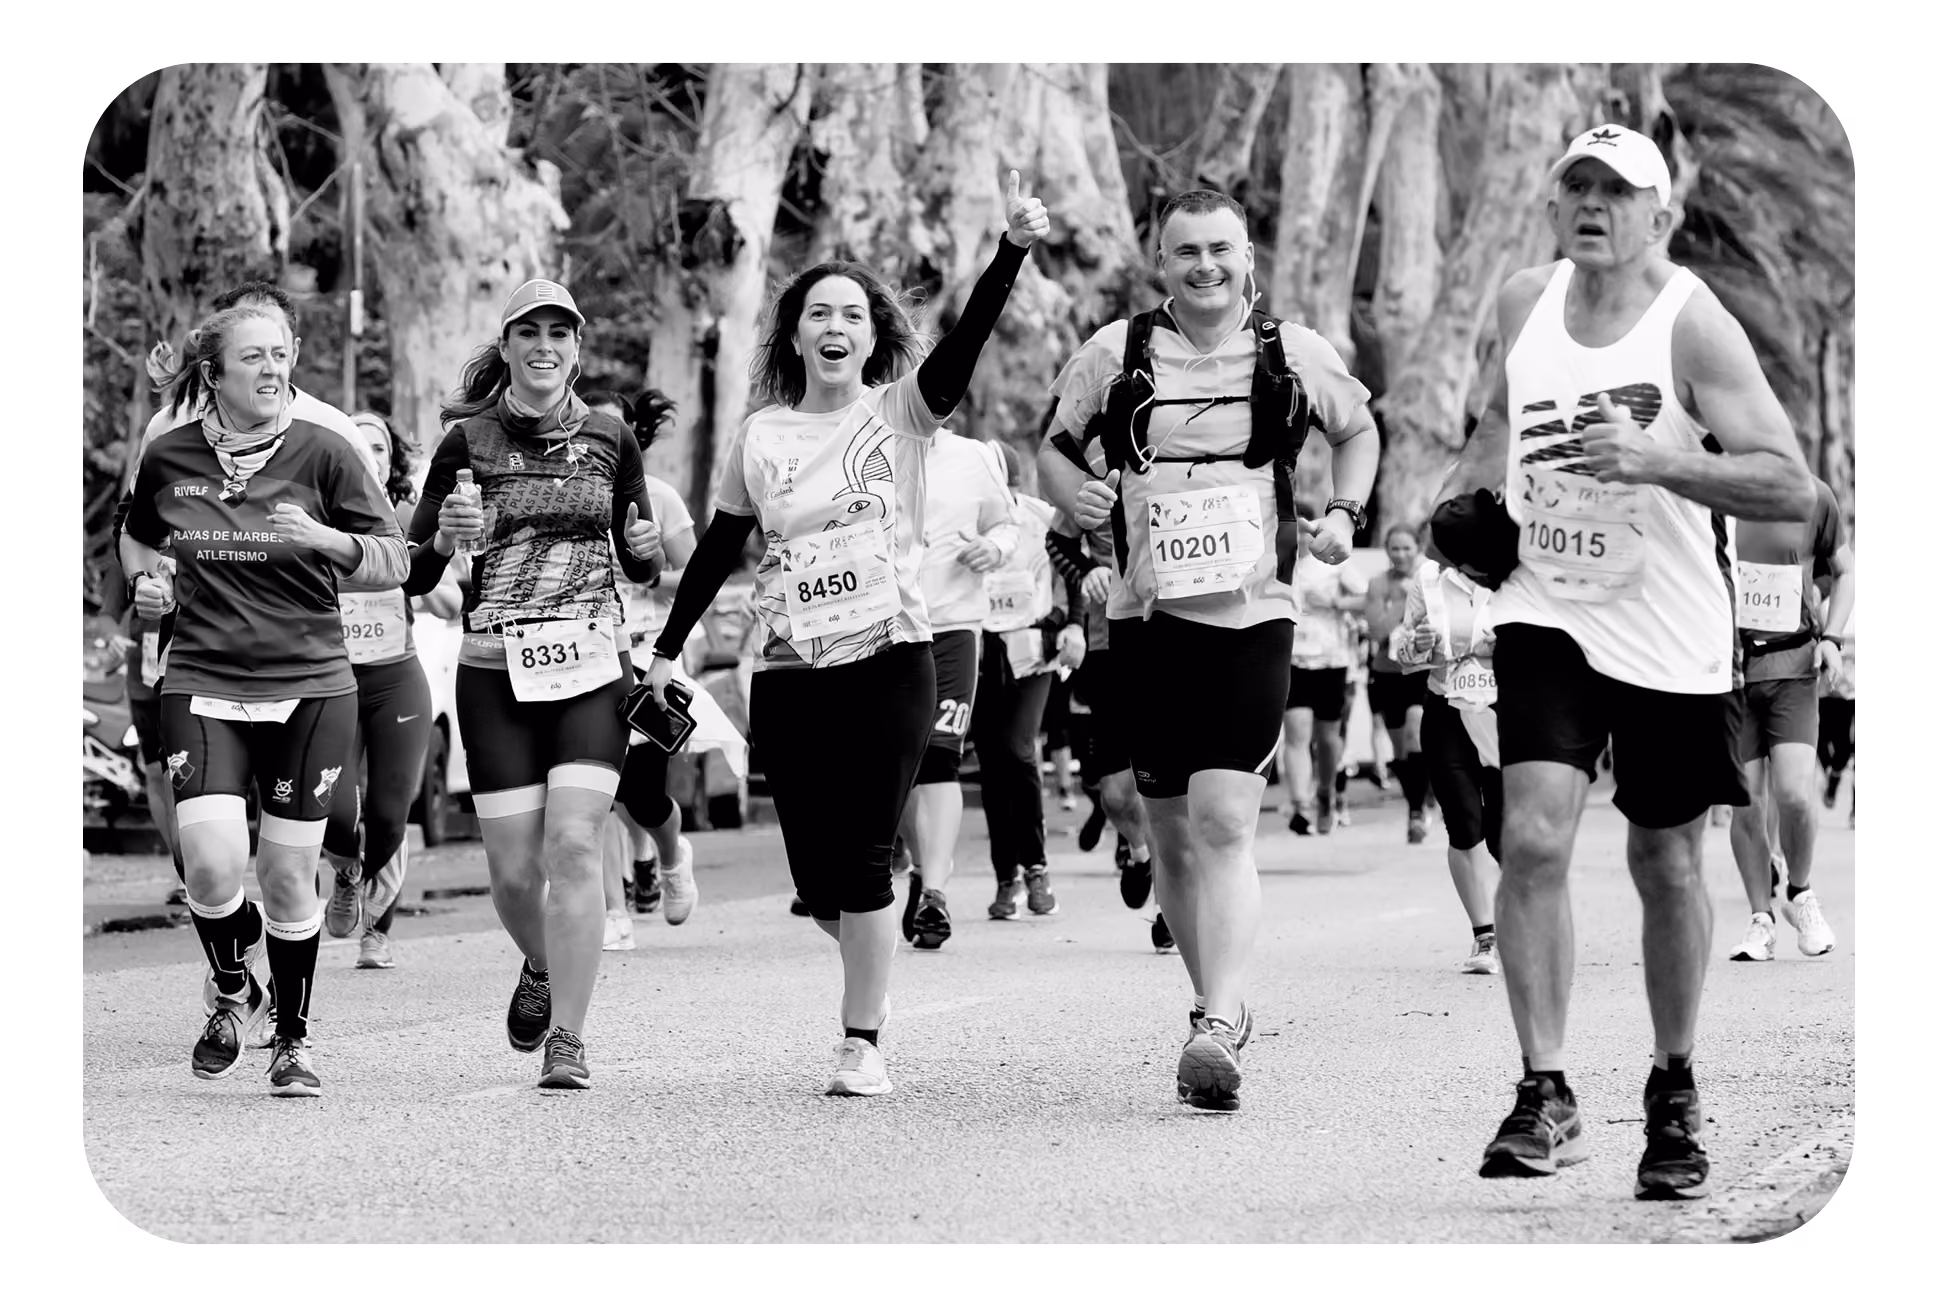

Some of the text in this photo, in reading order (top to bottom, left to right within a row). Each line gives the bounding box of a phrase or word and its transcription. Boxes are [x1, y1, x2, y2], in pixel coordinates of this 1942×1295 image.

[174, 530, 284, 543] PLAYAS DE MARBE
[1156, 531, 1230, 562] 10201
[1528, 520, 1605, 558] 10015
[196, 550, 268, 562] ATLETISMO
[797, 570, 857, 603] 8450
[1744, 592, 1780, 609] 1041
[341, 623, 384, 640] 0926
[521, 641, 579, 668] 8331
[934, 699, 969, 735] 20
